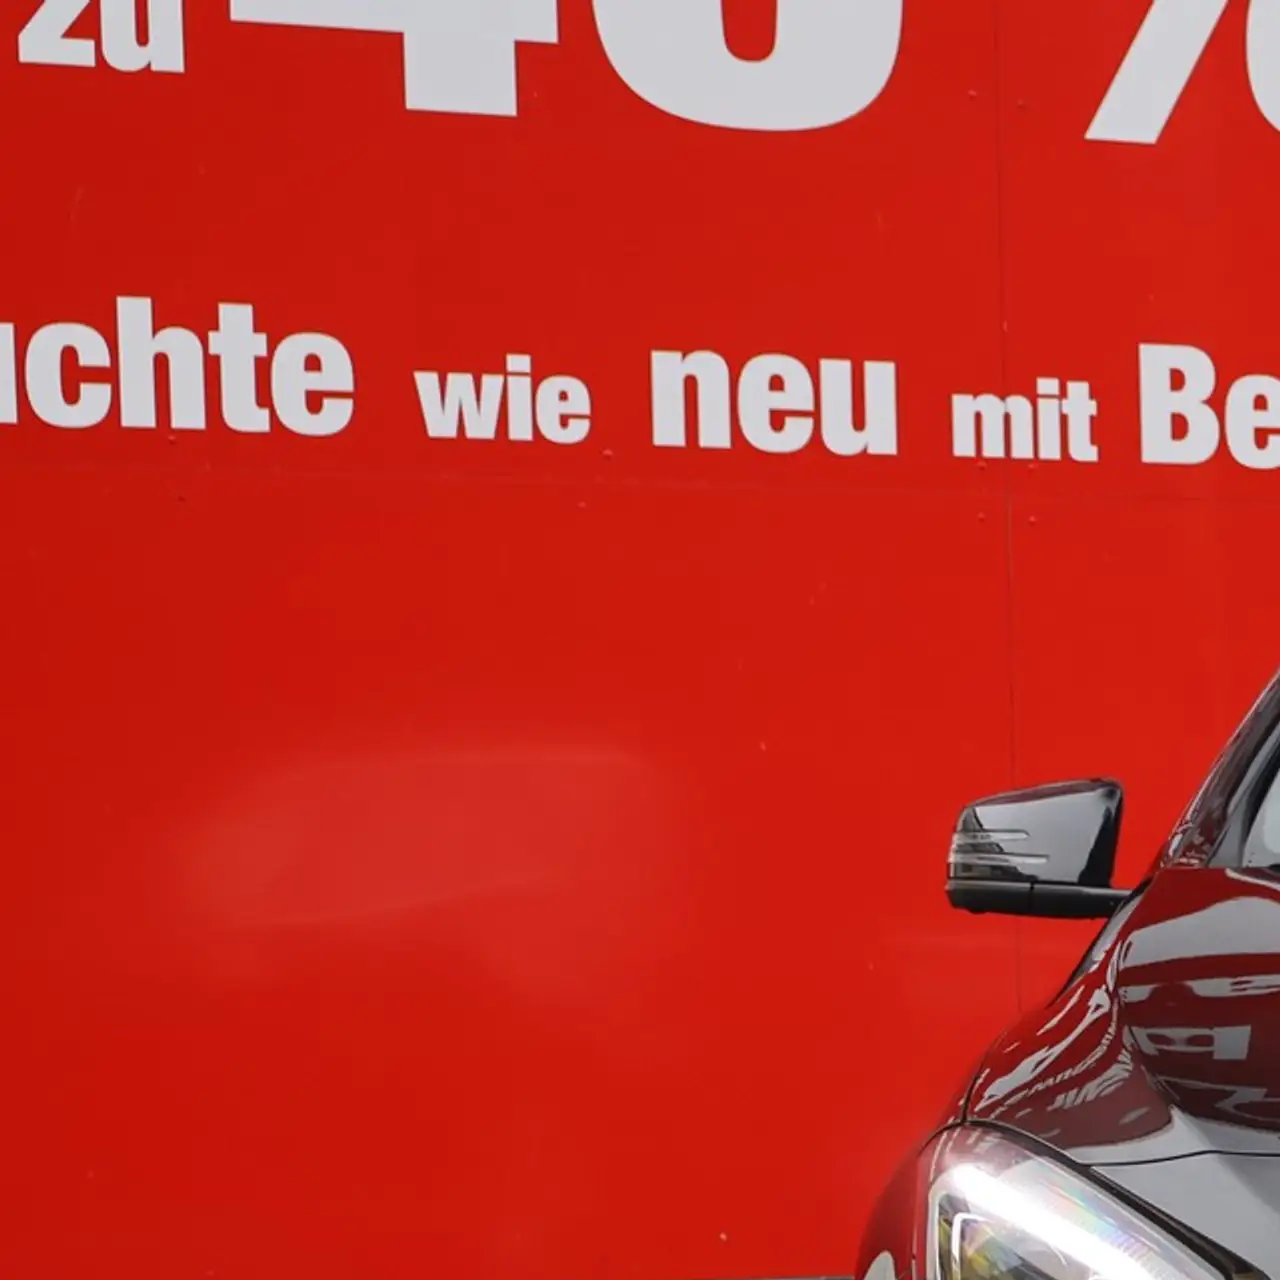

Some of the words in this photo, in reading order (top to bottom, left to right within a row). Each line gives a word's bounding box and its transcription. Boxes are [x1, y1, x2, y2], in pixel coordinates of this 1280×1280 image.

[0, 296, 354, 436] chte
[415, 354, 591, 444] wie
[651, 350, 898, 456] neu
[952, 377, 1099, 462] mit
